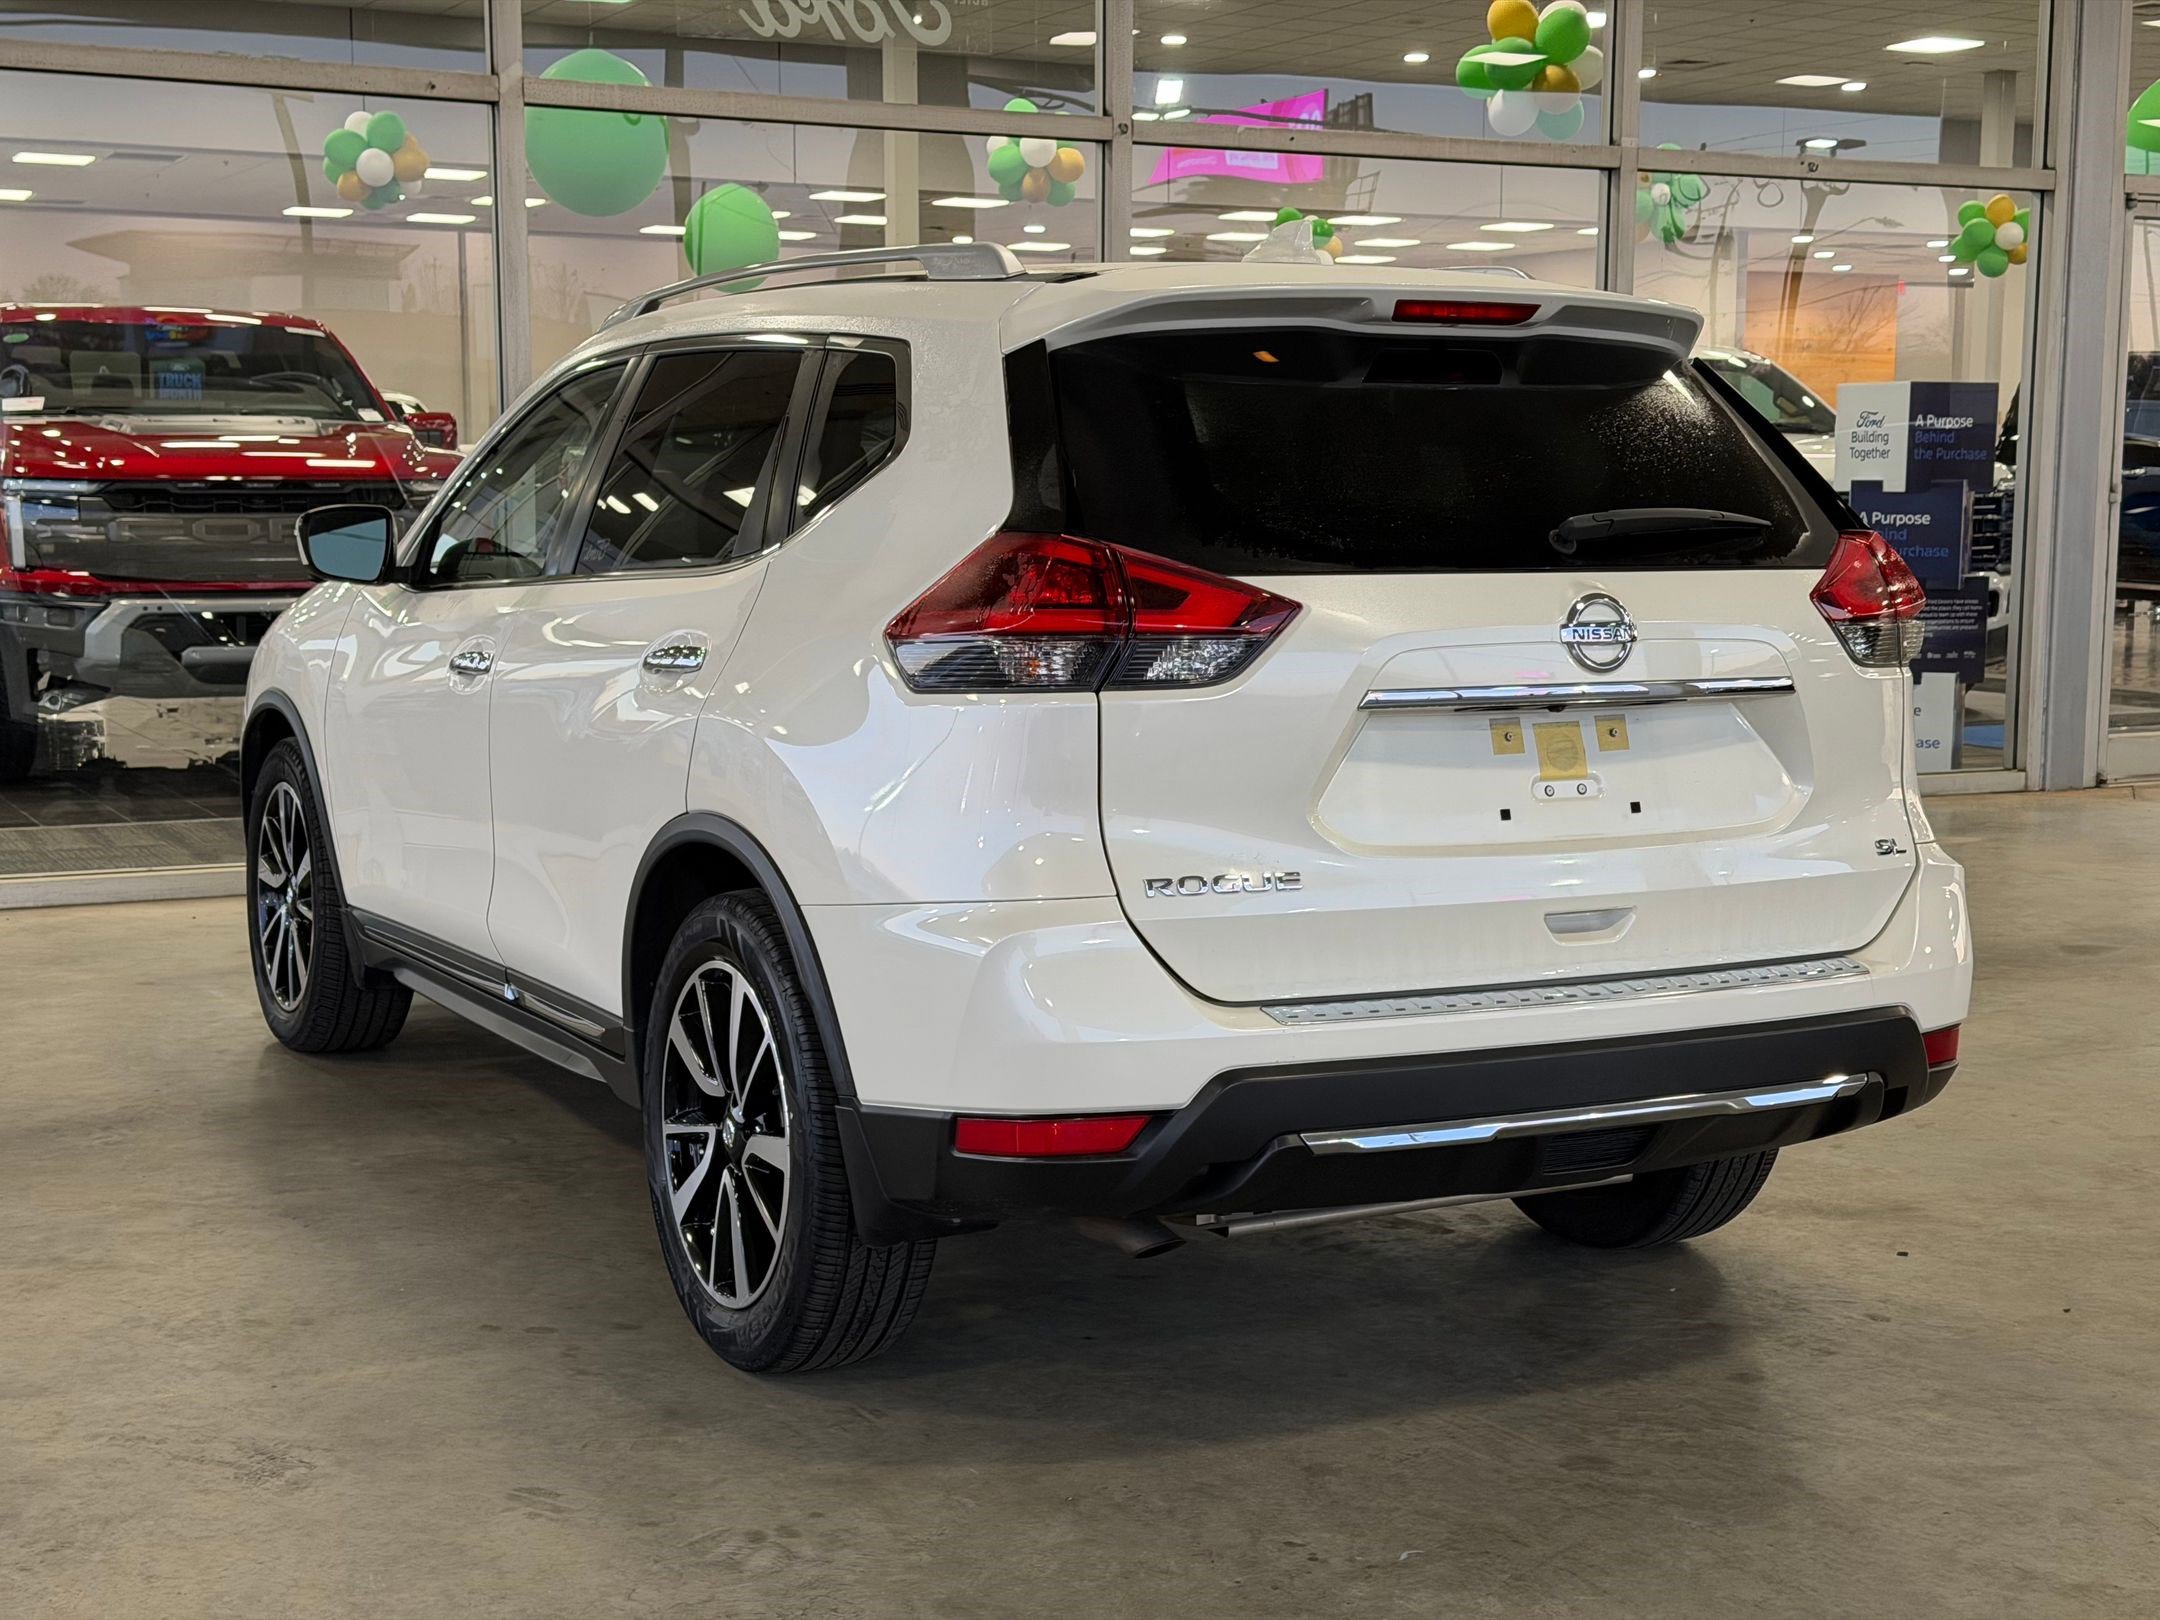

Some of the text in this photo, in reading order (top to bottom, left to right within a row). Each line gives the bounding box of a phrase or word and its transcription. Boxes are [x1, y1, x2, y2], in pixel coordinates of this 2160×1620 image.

[1856, 410, 1885, 428] Ford
[1915, 414, 1974, 429] A Purpose
[1851, 431, 1889, 445] Building
[1914, 431, 1955, 443] Behind
[1849, 447, 1891, 461] Together
[1913, 448, 1987, 460] the Purchase
[1872, 511, 1931, 527] Purpose
[1572, 628, 1633, 640] NISSAN
[1875, 838, 1907, 856] SL
[1143, 871, 1303, 898] ROGUE
